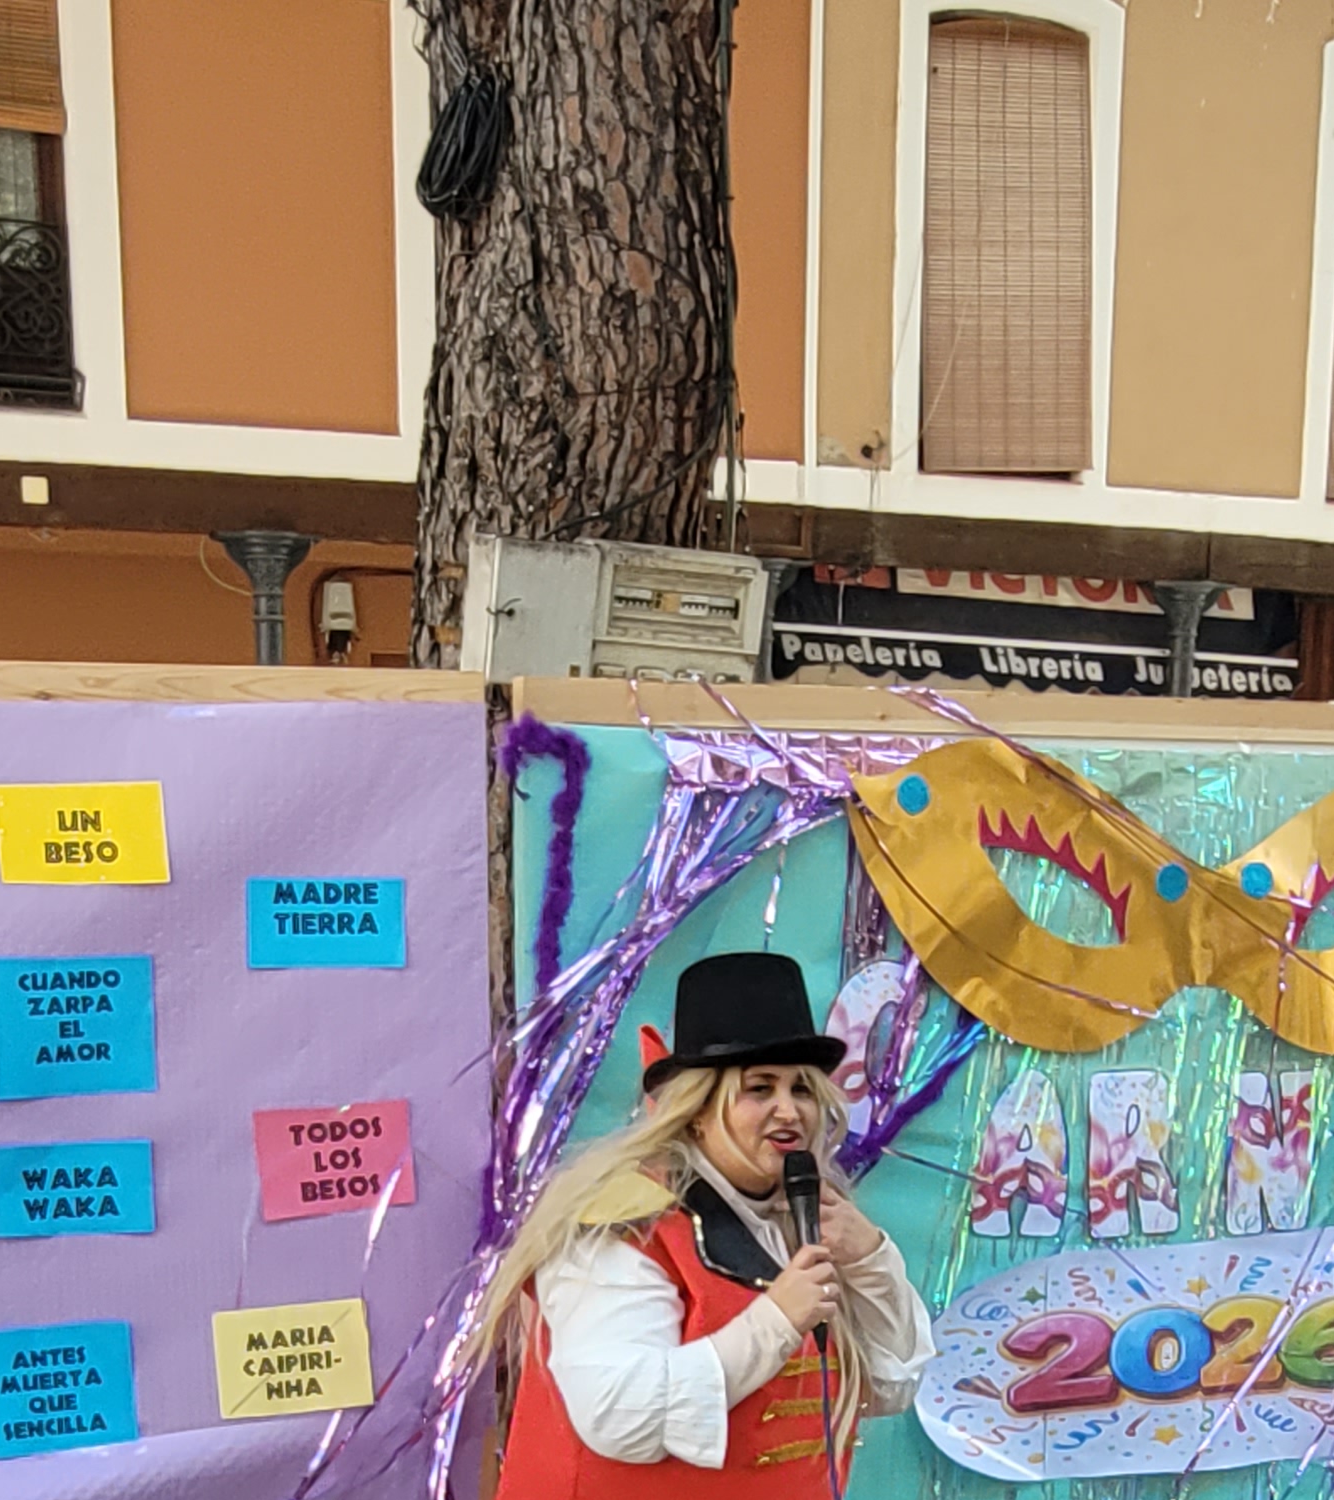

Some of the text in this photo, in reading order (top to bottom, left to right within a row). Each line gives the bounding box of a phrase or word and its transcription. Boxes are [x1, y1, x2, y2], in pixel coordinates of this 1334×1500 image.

[57, 809, 103, 833] UN
[44, 842, 120, 864] BESO
[272, 882, 379, 906] MADRE
[273, 911, 379, 936] TIERRA
[18, 970, 121, 992] CUANDO
[27, 994, 114, 1016] ZARPA
[59, 1020, 86, 1040] EL
[35, 1042, 112, 1064] AMOR
[289, 1116, 383, 1145] TODOS
[314, 1147, 363, 1174] LOS
[22, 1165, 119, 1190] WAKA
[299, 1173, 381, 1203] BESOS
[23, 1195, 120, 1221] WAKA
[245, 1324, 336, 1352] MARIA
[11, 1344, 88, 1372] ANTES
[243, 1350, 344, 1378] CAIPIRI-
[0, 1368, 104, 1397] MUERTA
[265, 1375, 323, 1402] NHA
[28, 1391, 79, 1417] QUE
[3, 1411, 108, 1442] SENCILLA
